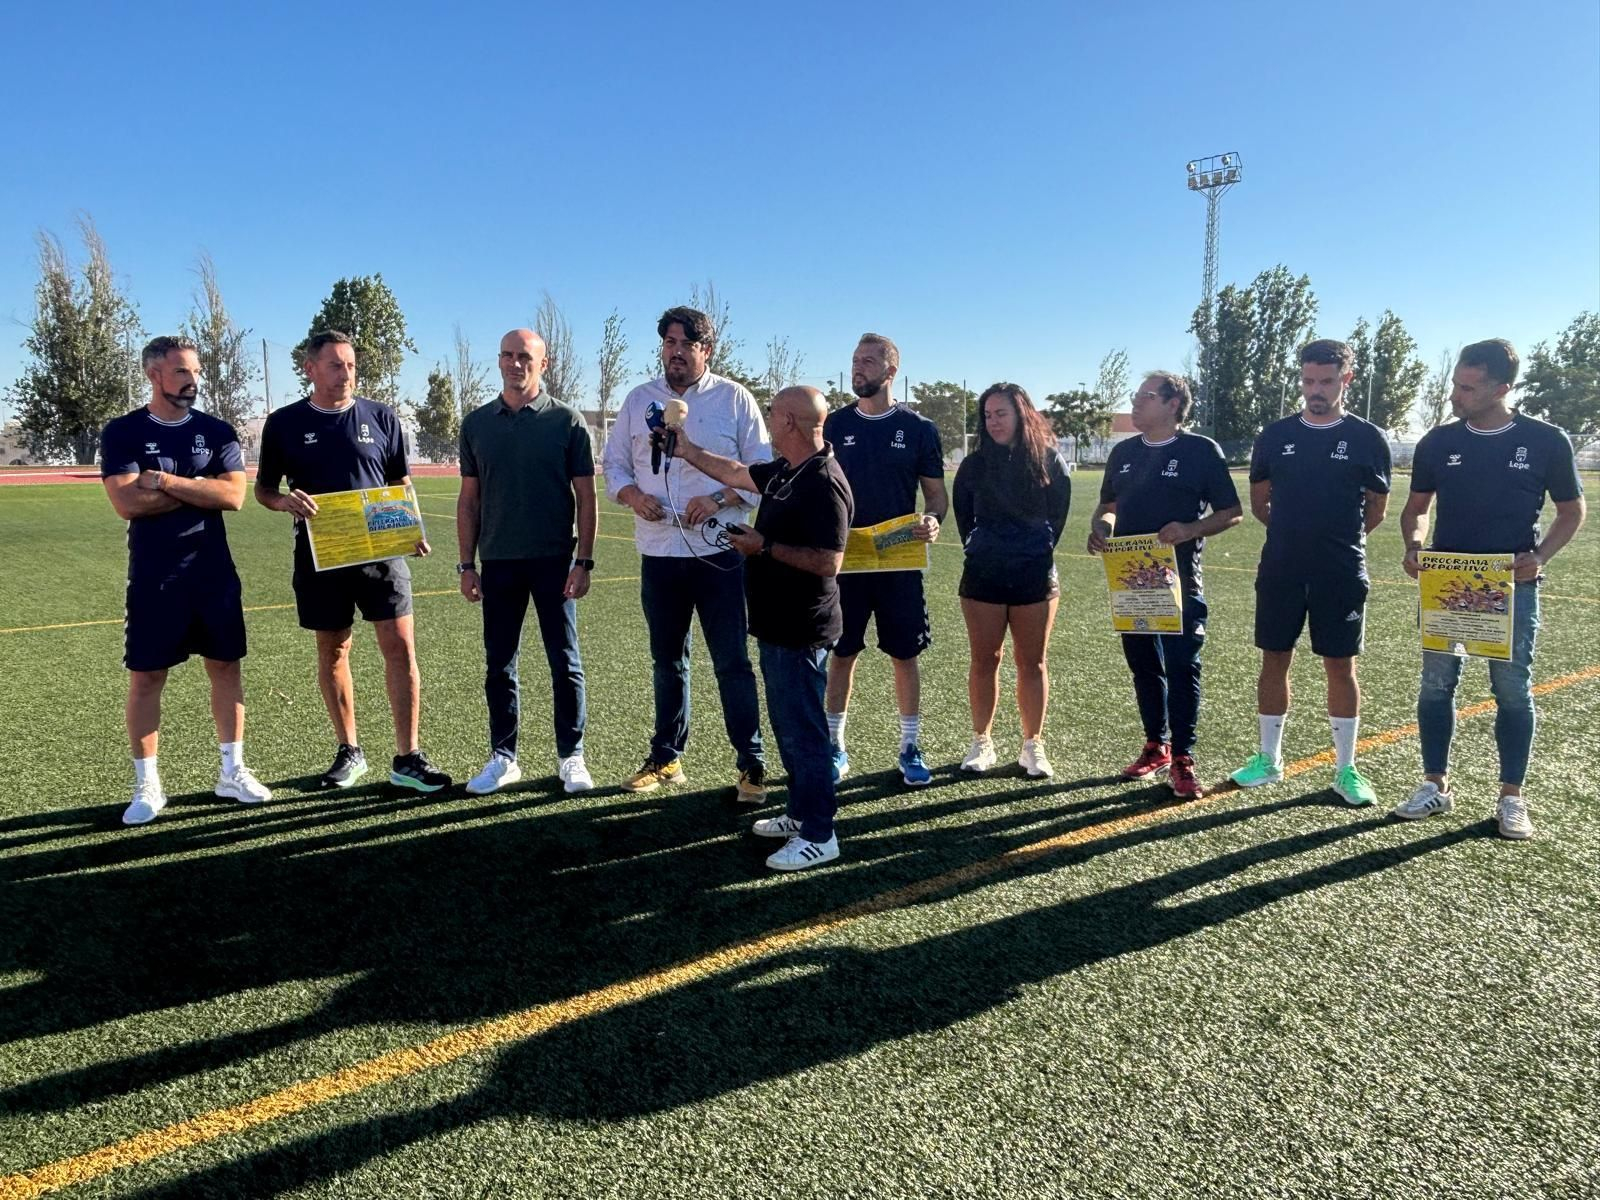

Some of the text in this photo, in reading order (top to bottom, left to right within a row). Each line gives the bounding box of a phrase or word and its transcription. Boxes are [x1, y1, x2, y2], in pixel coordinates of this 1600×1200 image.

[191, 446, 210, 455] Lepe
[1330, 452, 1349, 460] Lepe
[1508, 460, 1530, 470] Lepe
[1422, 556, 1489, 566] PROGRAMA
[1422, 562, 1489, 572] DEPORTIVO
